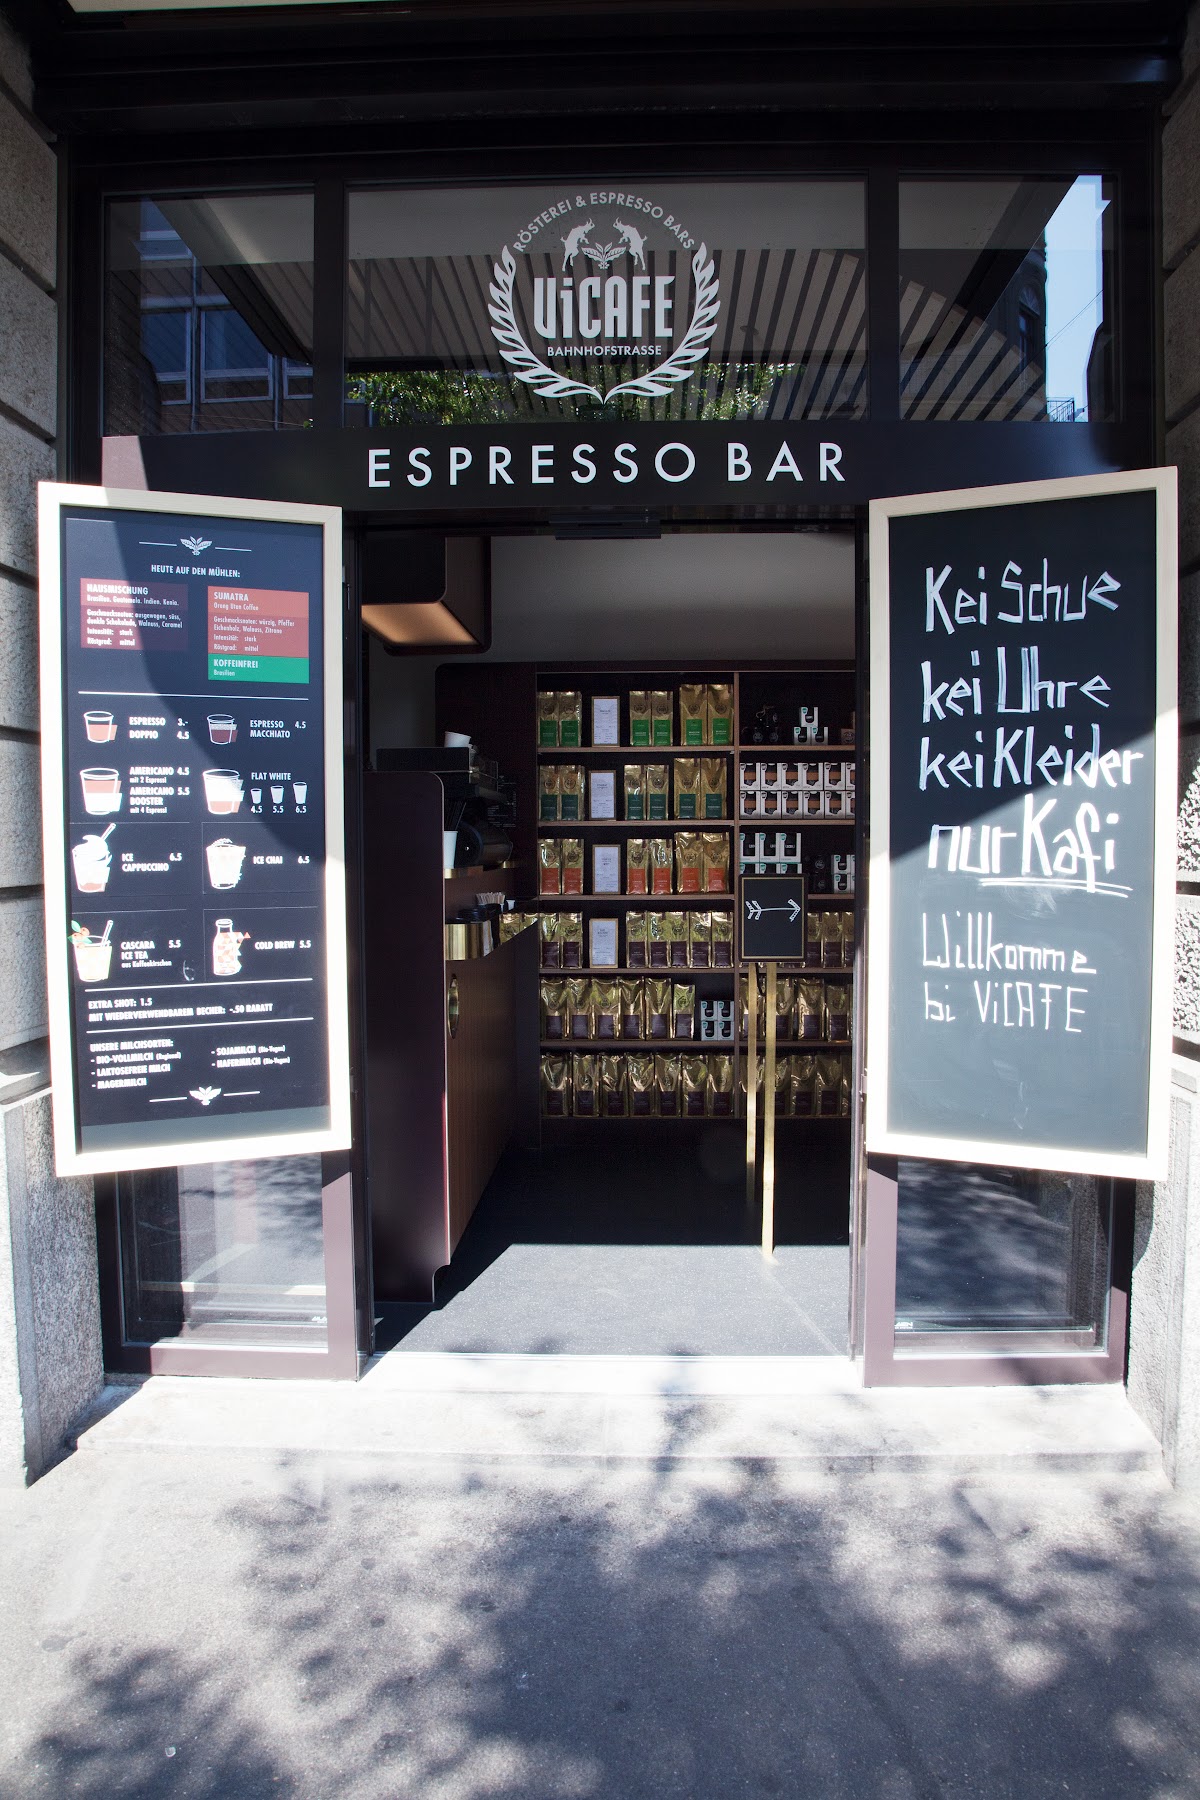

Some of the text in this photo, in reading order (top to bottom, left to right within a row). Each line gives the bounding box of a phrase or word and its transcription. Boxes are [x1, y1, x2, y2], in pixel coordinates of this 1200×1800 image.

[513, 192, 695, 252] RÖSTEREI & ESPRESSO BARS
[547, 345, 662, 357] BAHNHOFSTRASSE
[368, 440, 846, 488] ESPRESSO BAR
[151, 565, 240, 577] HEUTE AUF DEN MÜHLEN:
[87, 584, 149, 595] HAUSMISCHUNG
[213, 592, 249, 602] SUMATRA
[925, 558, 1121, 634] Kei Schue
[213, 659, 259, 669] KOFFEINFREI
[921, 646, 1111, 723] kei Uhre
[129, 716, 166, 726] ESPRESSO
[249, 720, 307, 729] ESPRESSO 4.5
[129, 730, 190, 739] DOPPIO 4.5
[249, 730, 291, 738] MACCHIATO
[919, 723, 1144, 791] kei Kleider
[129, 766, 190, 776] AMERICANO 4.5
[251, 772, 267, 780] FLAT
[129, 787, 190, 795] AMERICANO 5.5
[129, 797, 164, 805] BOOSTER
[928, 793, 1119, 893] nur Kafi
[169, 853, 182, 861] 6.5
[253, 856, 264, 864] ICE
[297, 856, 310, 864] 6.5
[122, 863, 169, 872] CAPPUCCINO
[121, 940, 181, 950] CASCARA 5.5
[255, 940, 311, 950] COLD BREW 5.5
[922, 910, 1097, 974] Willkomme
[121, 951, 148, 960] ICE TEA
[88, 998, 152, 1009] EXTRA SHOT: 1.5
[924, 982, 956, 1022] bi
[88, 1013, 103, 1022] MIT
[246, 1003, 273, 1013] RABATT
[90, 1042, 119, 1052] UNSERE
[216, 1045, 256, 1056] SOJAMILCH
[217, 1057, 261, 1068] HAFERMILCH
[97, 1065, 147, 1077] LAKTOSEFREIE
[97, 1078, 147, 1089] MAGERMILCH
